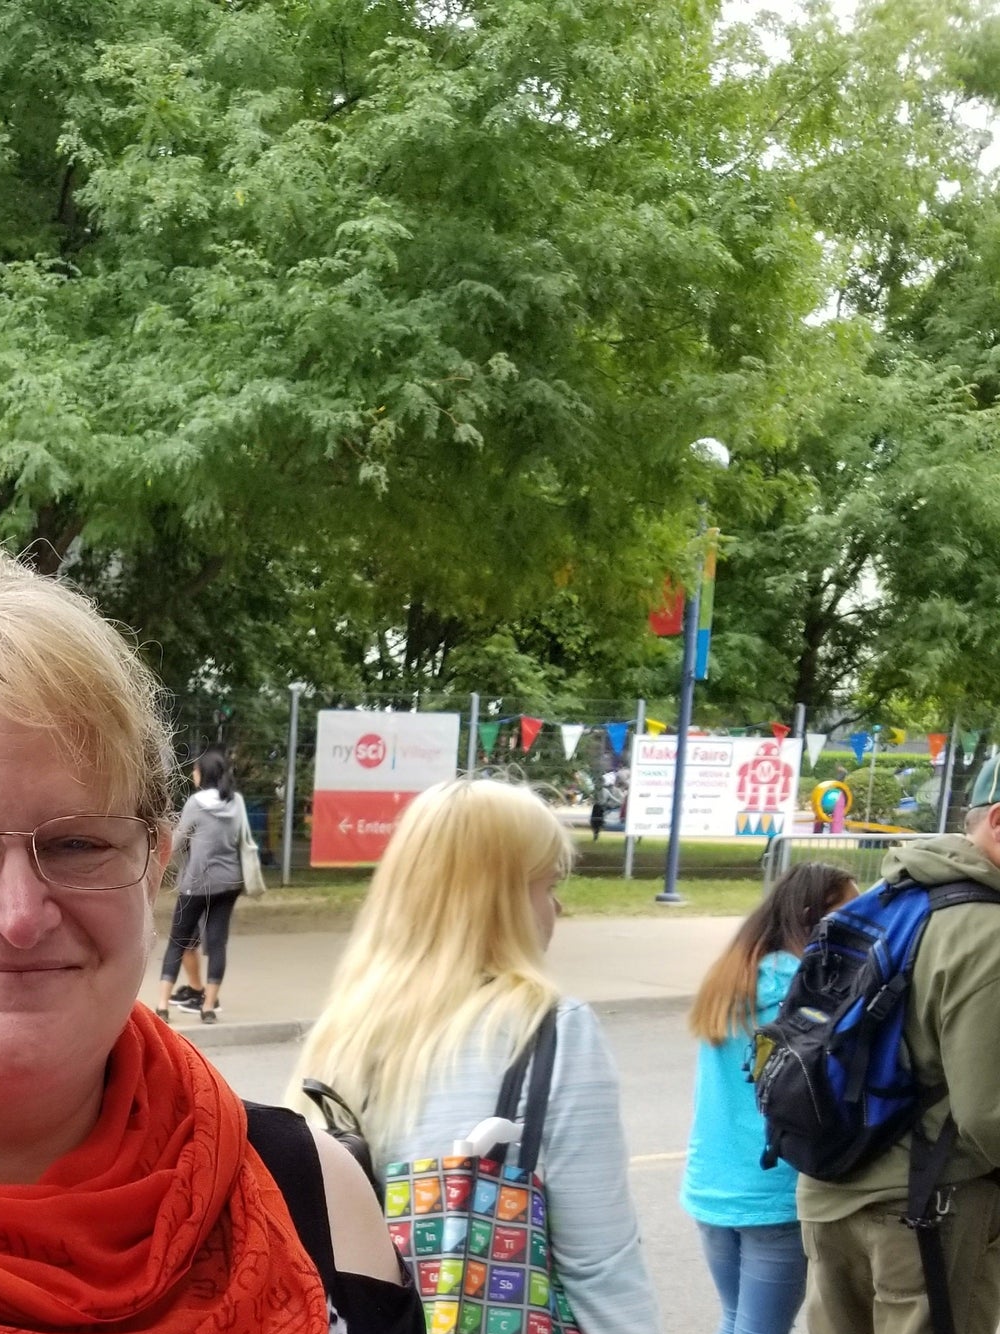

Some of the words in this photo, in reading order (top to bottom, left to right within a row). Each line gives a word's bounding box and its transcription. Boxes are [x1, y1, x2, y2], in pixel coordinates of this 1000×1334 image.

[692, 747, 728, 762] Faire
[426, 1232, 437, 1242] In
[504, 1239, 515, 1250] Ti
[499, 1279, 513, 1290] Sb
[500, 1320, 509, 1331] C
